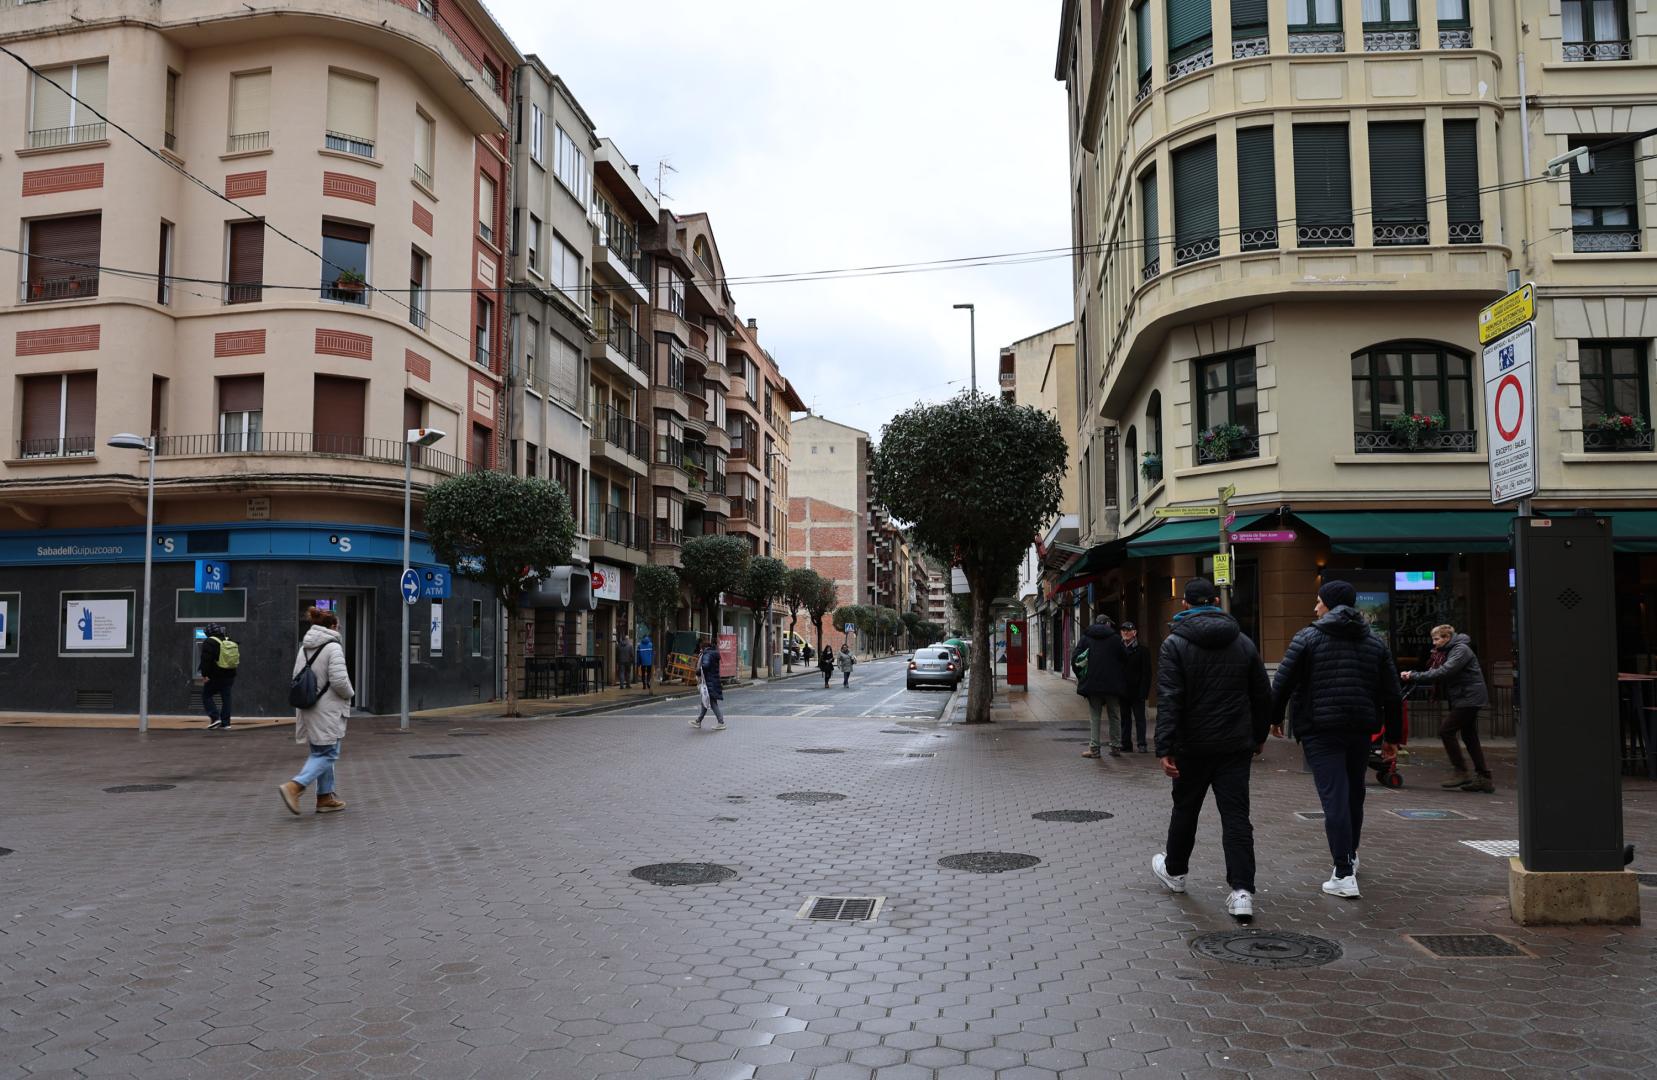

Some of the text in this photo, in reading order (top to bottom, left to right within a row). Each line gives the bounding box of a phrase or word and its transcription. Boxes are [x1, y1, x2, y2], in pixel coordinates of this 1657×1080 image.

[37, 545, 123, 558] SabadellGuipuzcoano
[1215, 555, 1227, 563] TAXI
[206, 582, 220, 591] ATM
[425, 587, 443, 596] ATM
